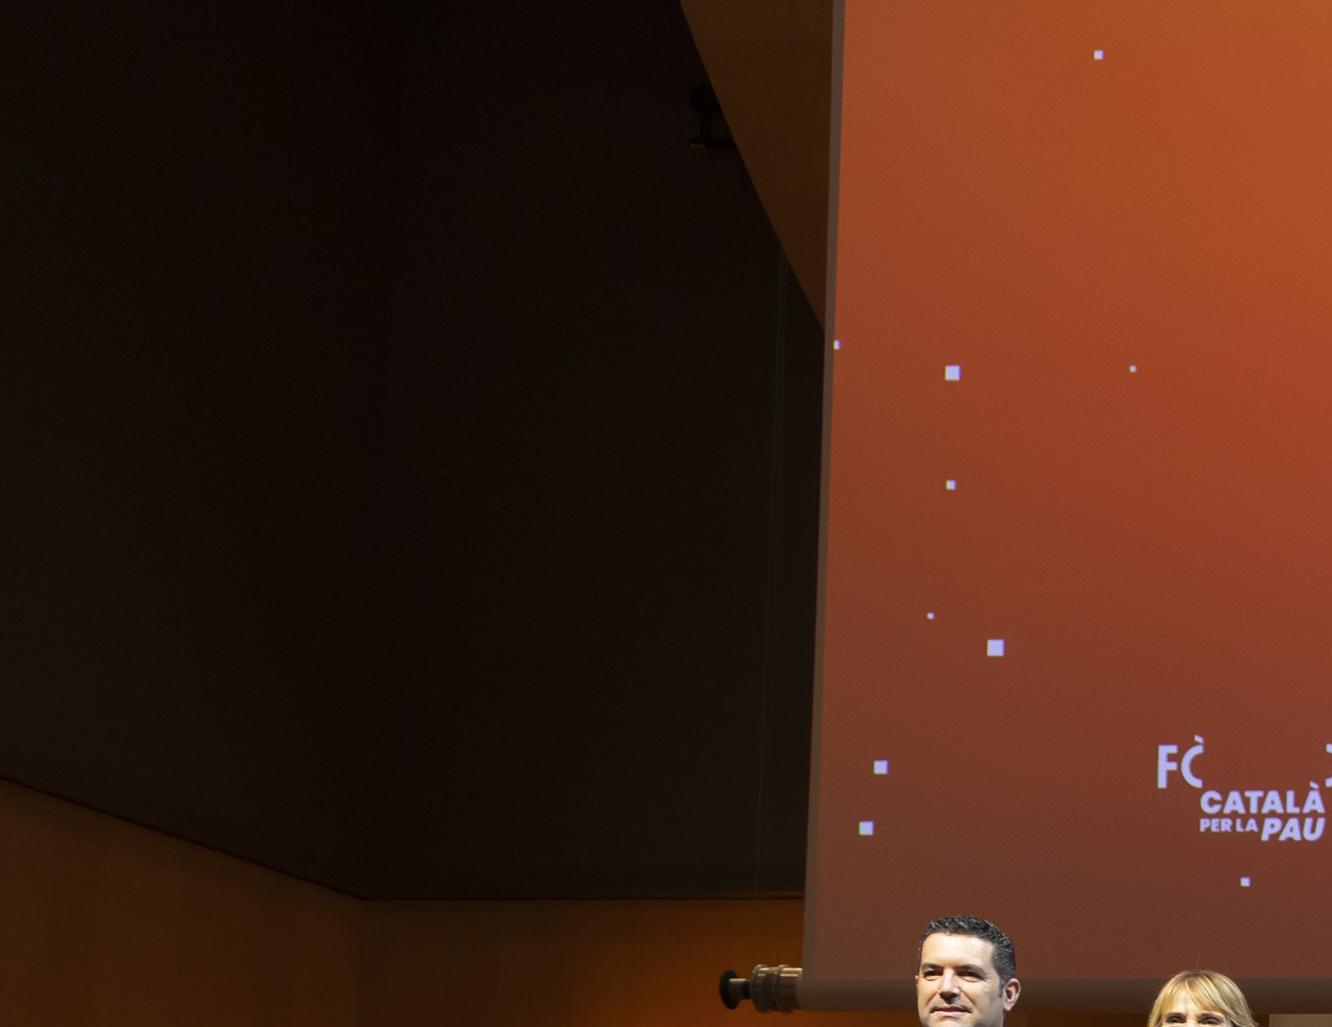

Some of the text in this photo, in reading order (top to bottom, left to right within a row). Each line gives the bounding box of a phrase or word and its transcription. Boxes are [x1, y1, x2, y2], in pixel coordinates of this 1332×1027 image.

[1200, 781, 1326, 814] CATALÀ
[1200, 817, 1326, 841] PER LA PAU
